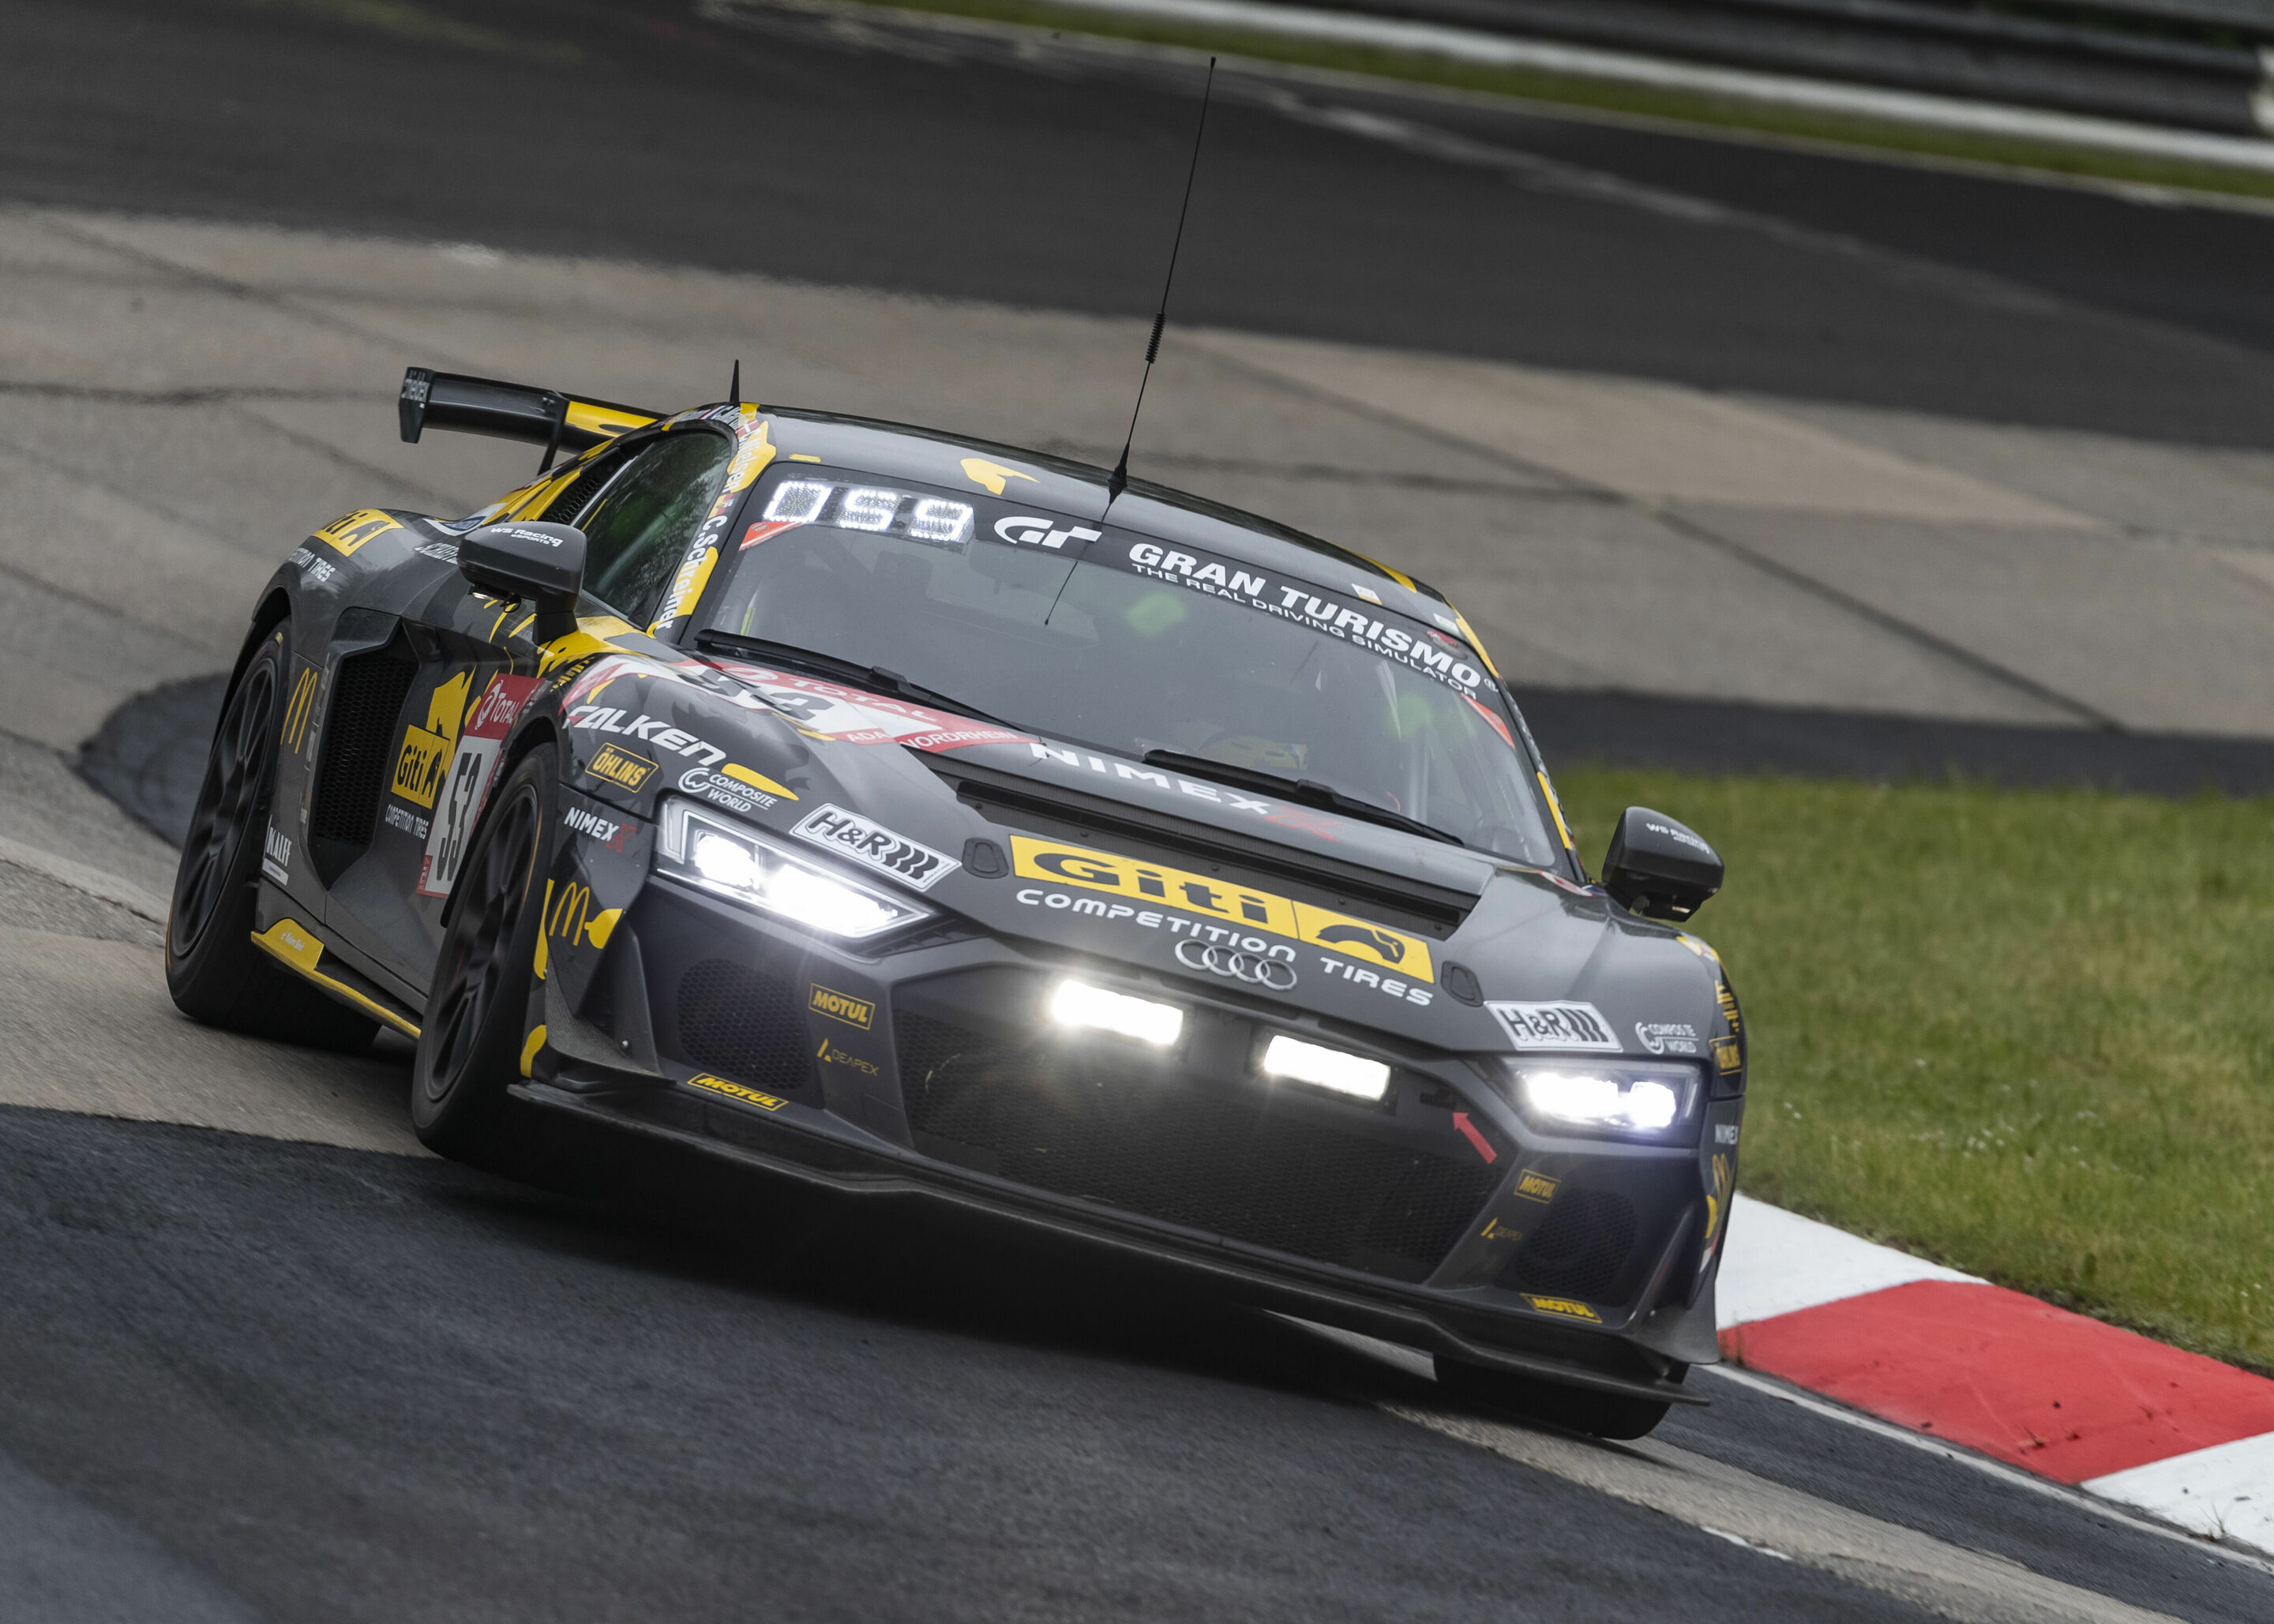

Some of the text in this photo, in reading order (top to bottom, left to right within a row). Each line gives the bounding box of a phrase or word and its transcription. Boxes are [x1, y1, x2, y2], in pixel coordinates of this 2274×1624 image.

[763, 481, 973, 542] 059
[514, 529, 564, 548] Racing
[1129, 543, 1484, 688] GRAN TURISMO
[1131, 564, 1179, 583] THE
[1186, 579, 1246, 603] REAL
[1251, 598, 1345, 639] DRIVING
[1351, 635, 1477, 700] SIMULATOR
[790, 678, 937, 722] TOTAL
[561, 706, 726, 767] FALKEN
[846, 731, 891, 742] ADA
[899, 723, 1017, 749] NORDRHEIN
[397, 744, 427, 792] Giti
[593, 747, 647, 786] ÖHLINS
[1030, 742, 1270, 815] NIMEX
[707, 788, 752, 812] WORLD
[709, 774, 778, 807] COMPOSITE
[437, 752, 482, 881] 53
[564, 807, 619, 842] NIMEX
[806, 811, 893, 858] H&R
[1034, 853, 1269, 925] Giti
[1016, 888, 1433, 1006] COMPETITION TIRES
[813, 990, 869, 1022] MOTUL
[696, 1076, 782, 1108] MOTUL
[1519, 1176, 1555, 1198] MOTUL
[1532, 1297, 1595, 1318] MOTUL
